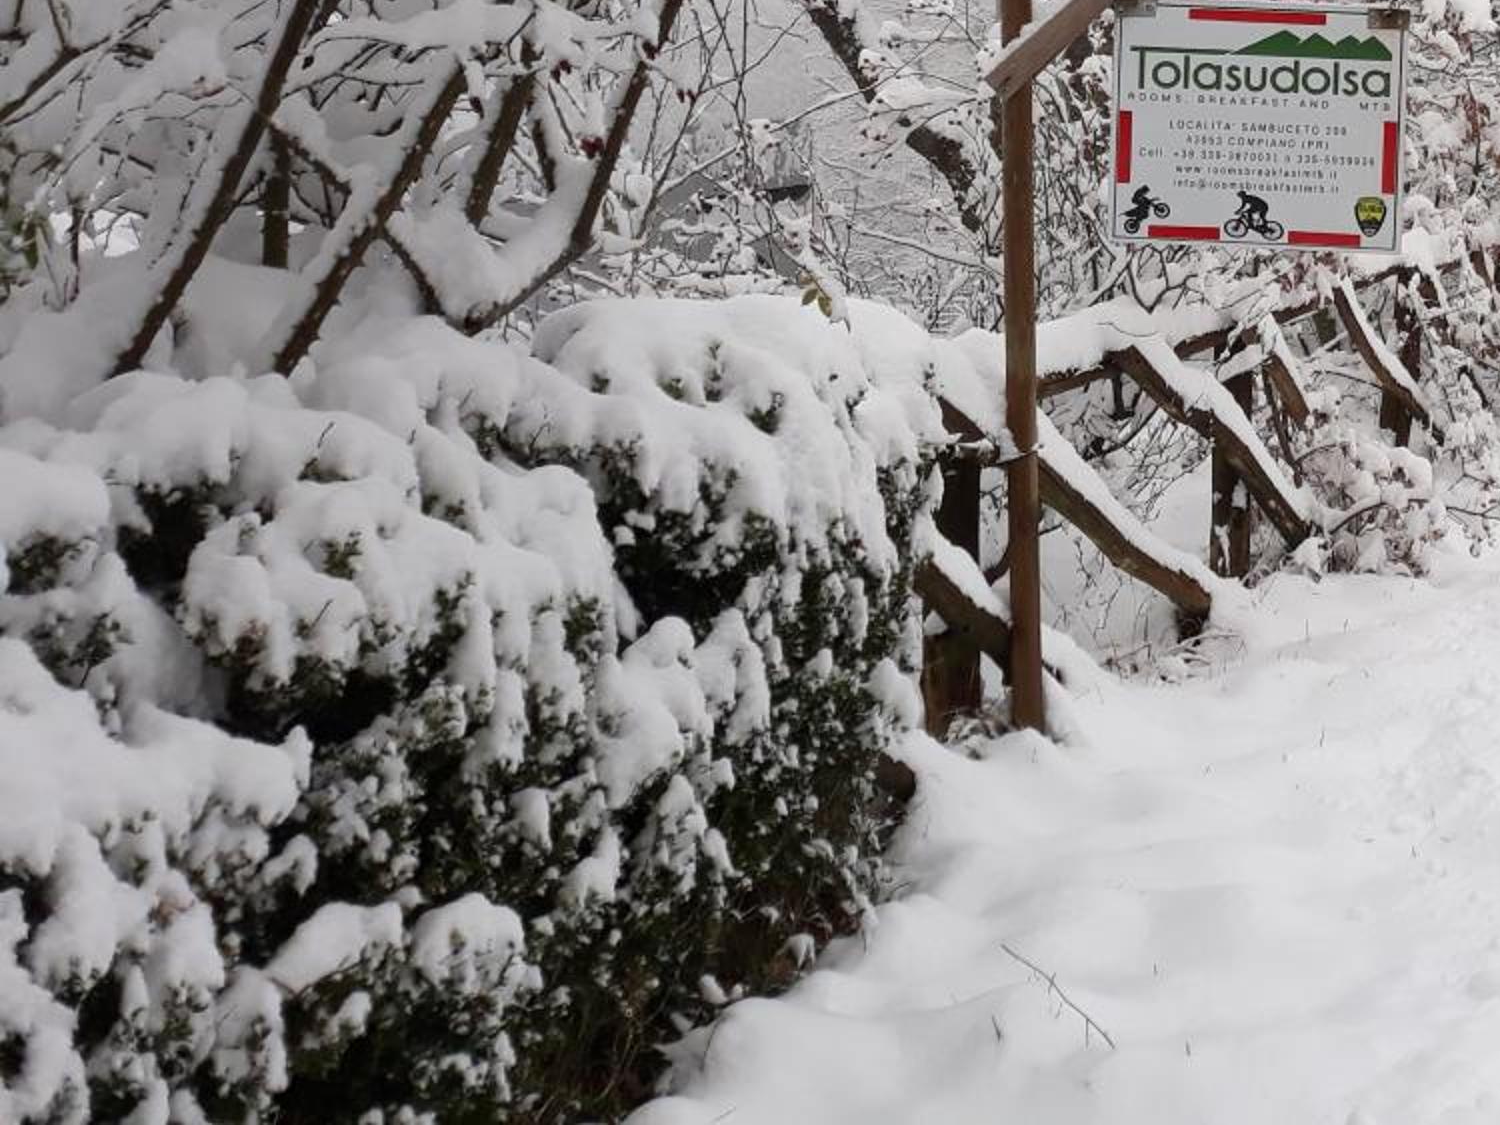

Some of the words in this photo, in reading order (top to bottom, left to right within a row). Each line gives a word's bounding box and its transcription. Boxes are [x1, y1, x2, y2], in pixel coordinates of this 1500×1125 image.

[1130, 46, 1392, 97] Tolasudolsa
[1197, 94, 1289, 108] BREAKFAST
[1299, 99, 1330, 110] AND
[1359, 101, 1391, 112] MTB
[1241, 121, 1321, 135] SAMBUCETO
[1227, 136, 1297, 149] COMPIANO
